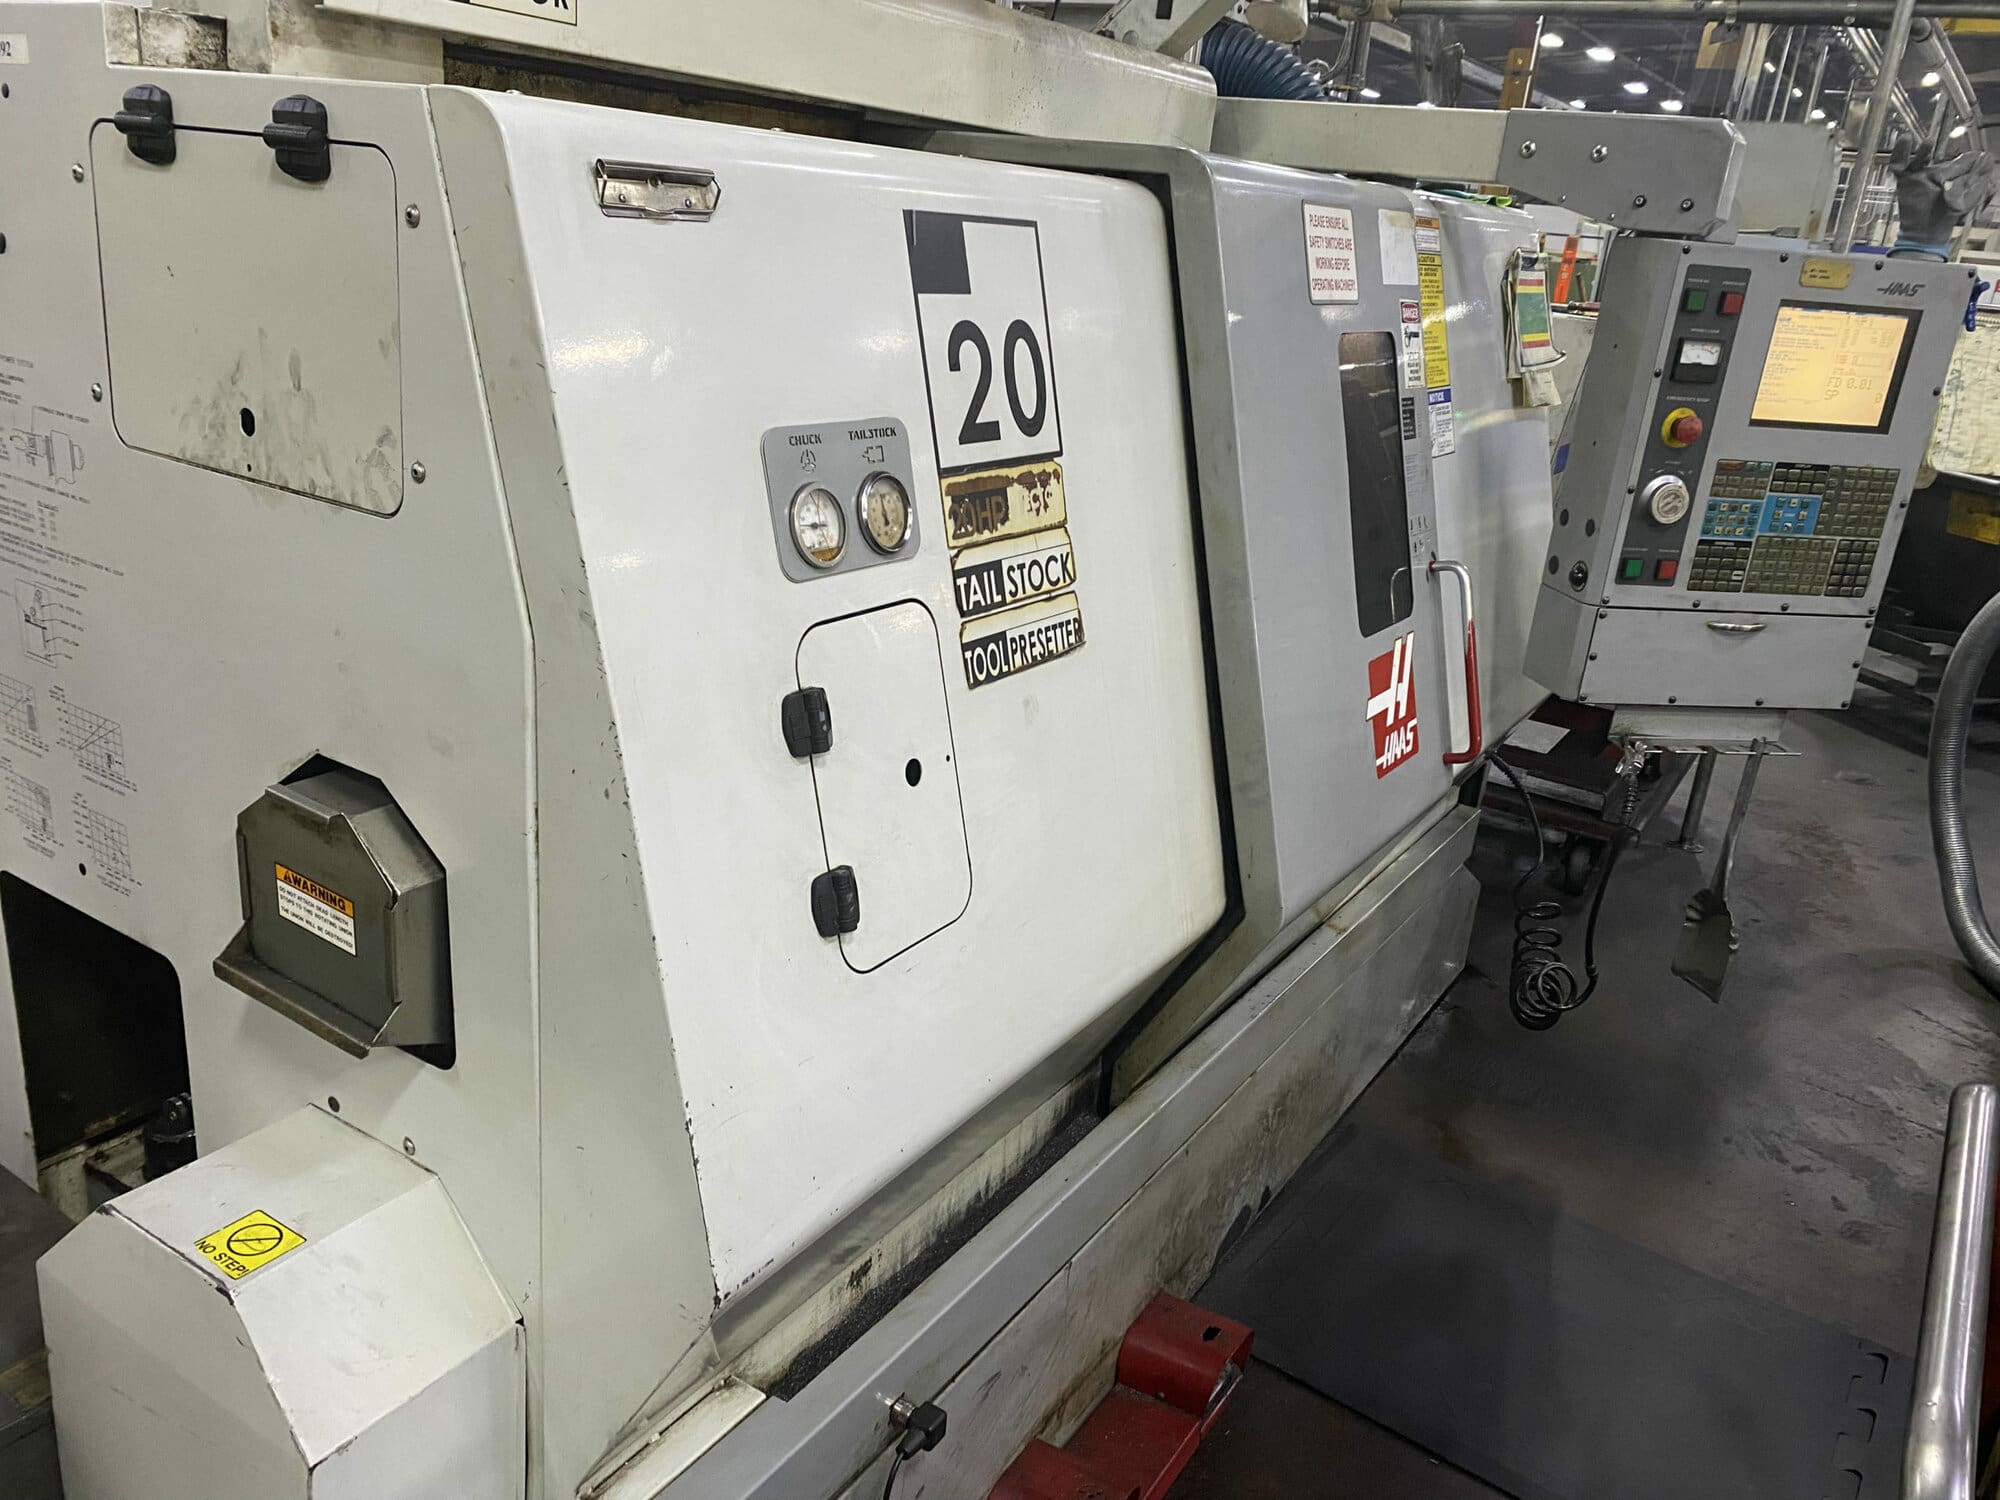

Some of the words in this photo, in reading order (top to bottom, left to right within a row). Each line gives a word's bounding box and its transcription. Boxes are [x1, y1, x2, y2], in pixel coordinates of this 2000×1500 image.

[0, 40, 11, 57] 92
[1309, 214, 1326, 228] PLEASE
[1326, 216, 1341, 230] ENSURE
[1309, 235, 1324, 248] SAFETY
[1325, 237, 1344, 250] SWITCHES
[1344, 238, 1352, 251] ARE
[1315, 256, 1334, 270] WORKING
[1334, 258, 1350, 271] BEFORE
[1312, 278, 1334, 291] OPERATING
[1877, 282, 1925, 296] HAAS
[948, 319, 1046, 445] 20
[788, 434, 822, 446] CHUCK
[848, 427, 897, 441] TAILSTOCK
[956, 569, 1002, 612] TAIL
[1006, 551, 1073, 598] STOCK
[964, 640, 1010, 684] TOOL
[1010, 617, 1083, 672] PRESETTER
[1376, 718, 1417, 769] HAAS
[291, 873, 346, 911] WARNING
[196, 1240, 216, 1254] NO
[214, 1252, 250, 1276] STEP!
